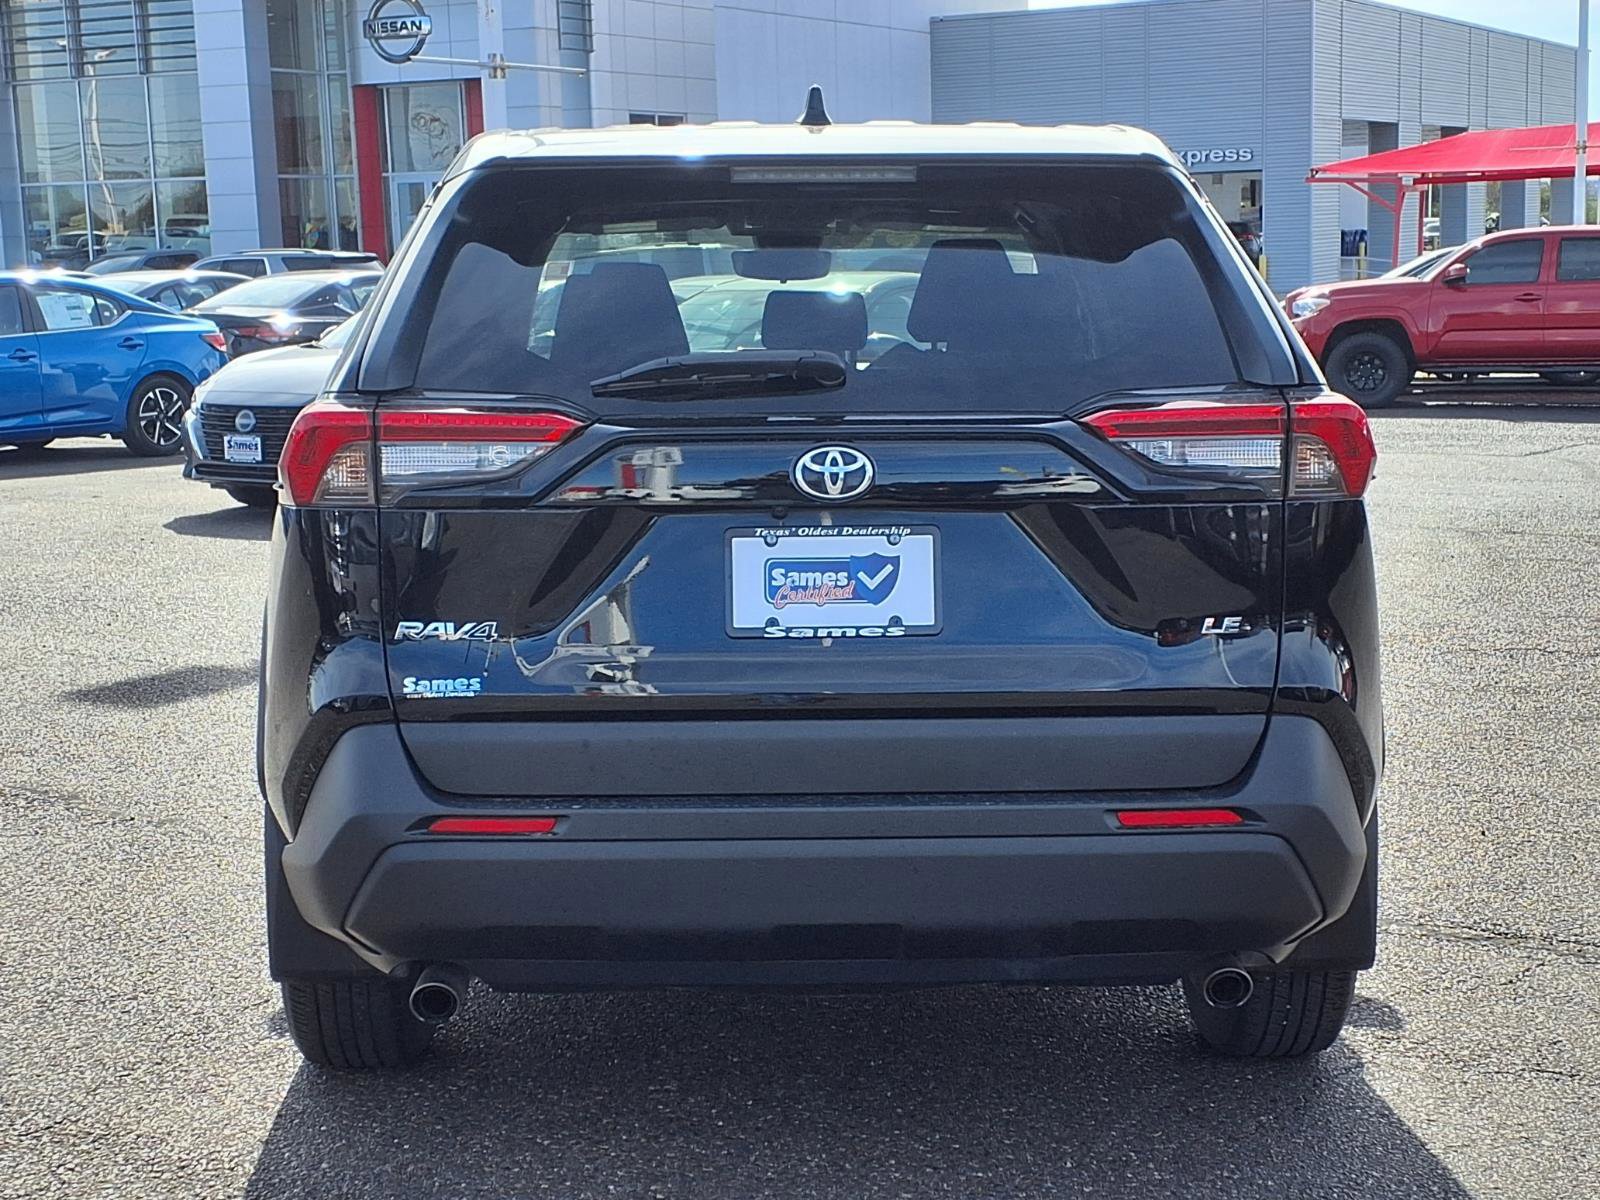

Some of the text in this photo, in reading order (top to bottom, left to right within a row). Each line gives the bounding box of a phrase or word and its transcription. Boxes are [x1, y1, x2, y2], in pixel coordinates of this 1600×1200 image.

[367, 20, 422, 34] NISSAN
[797, 527, 838, 536] Oldest
[841, 526, 911, 536] Dealership
[771, 568, 848, 586] Sames
[774, 580, 855, 609] Certified
[394, 621, 498, 642] RAV4
[763, 626, 906, 638] Sames
[1201, 616, 1242, 634] LE
[402, 676, 481, 694] Sames
